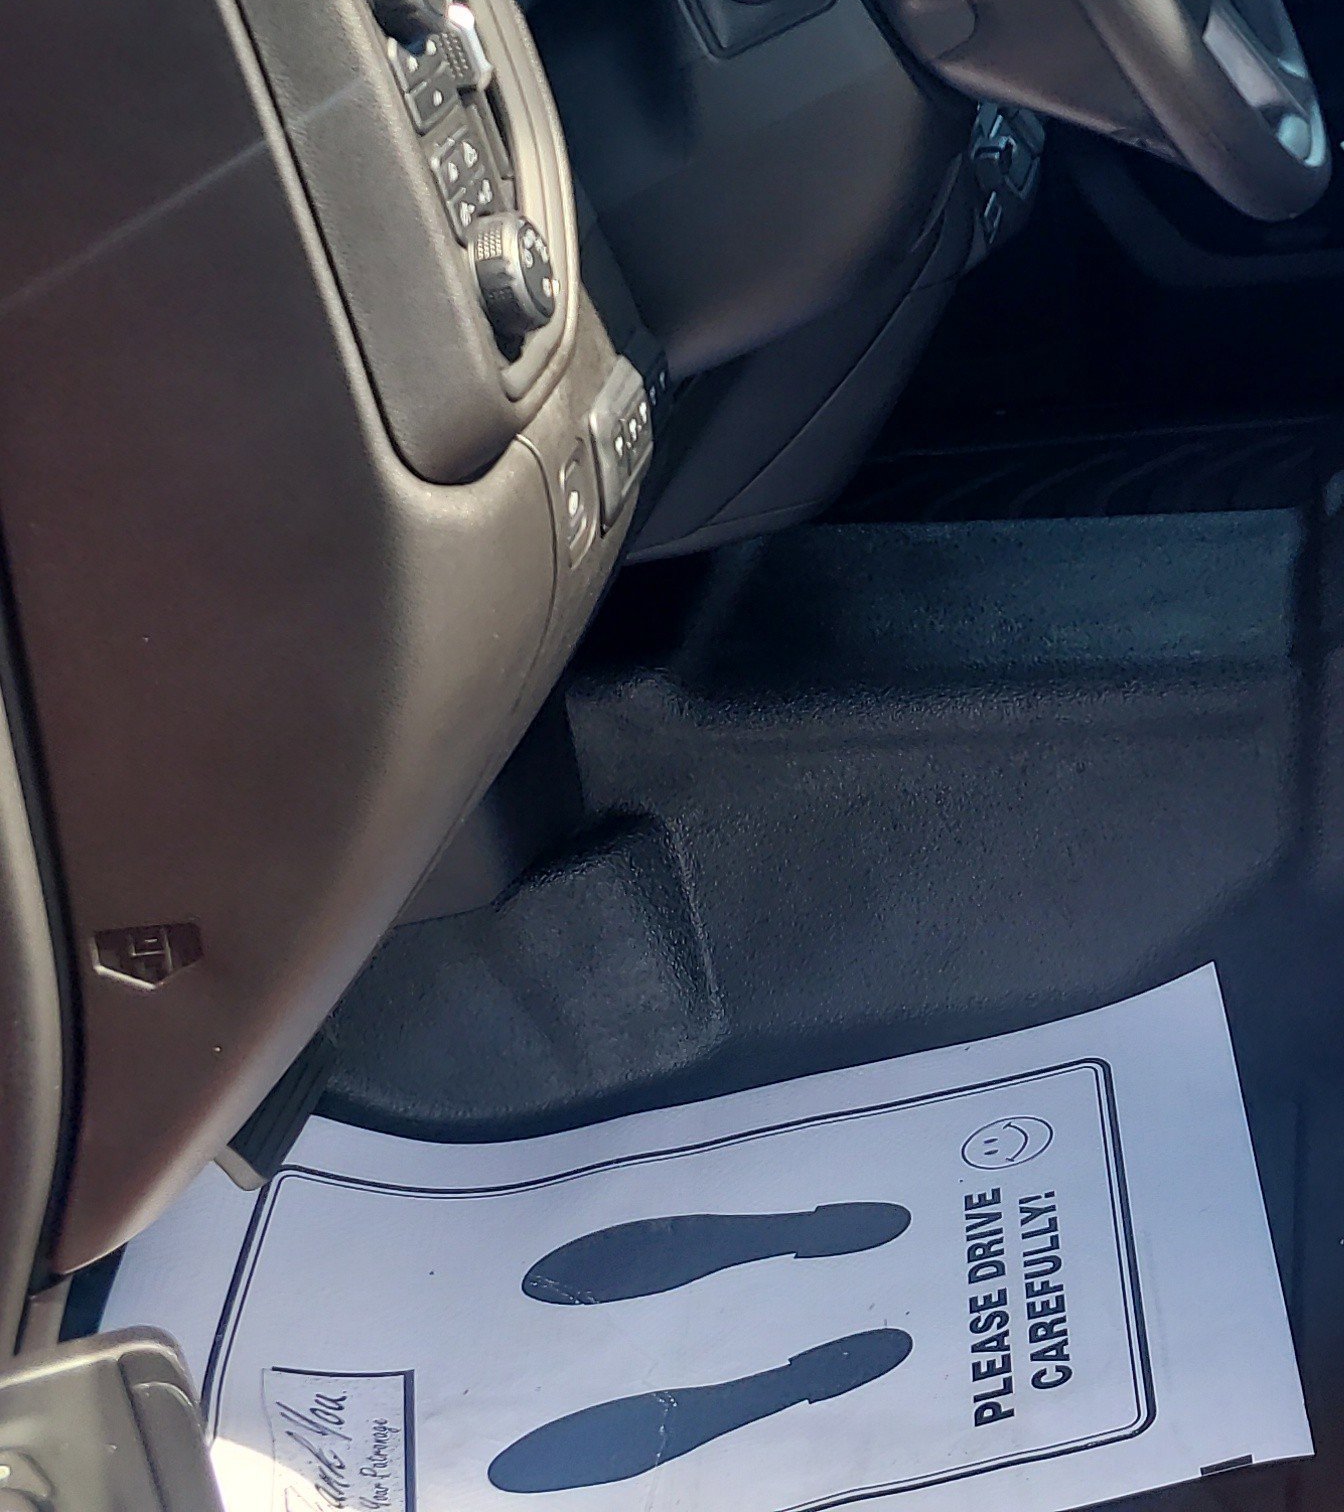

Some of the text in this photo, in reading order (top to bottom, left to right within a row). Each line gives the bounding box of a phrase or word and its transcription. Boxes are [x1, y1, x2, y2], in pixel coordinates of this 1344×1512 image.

[964, 1187, 1015, 1428] PLEASE DRIVE
[1018, 1190, 1074, 1390] CAREFULLY!
